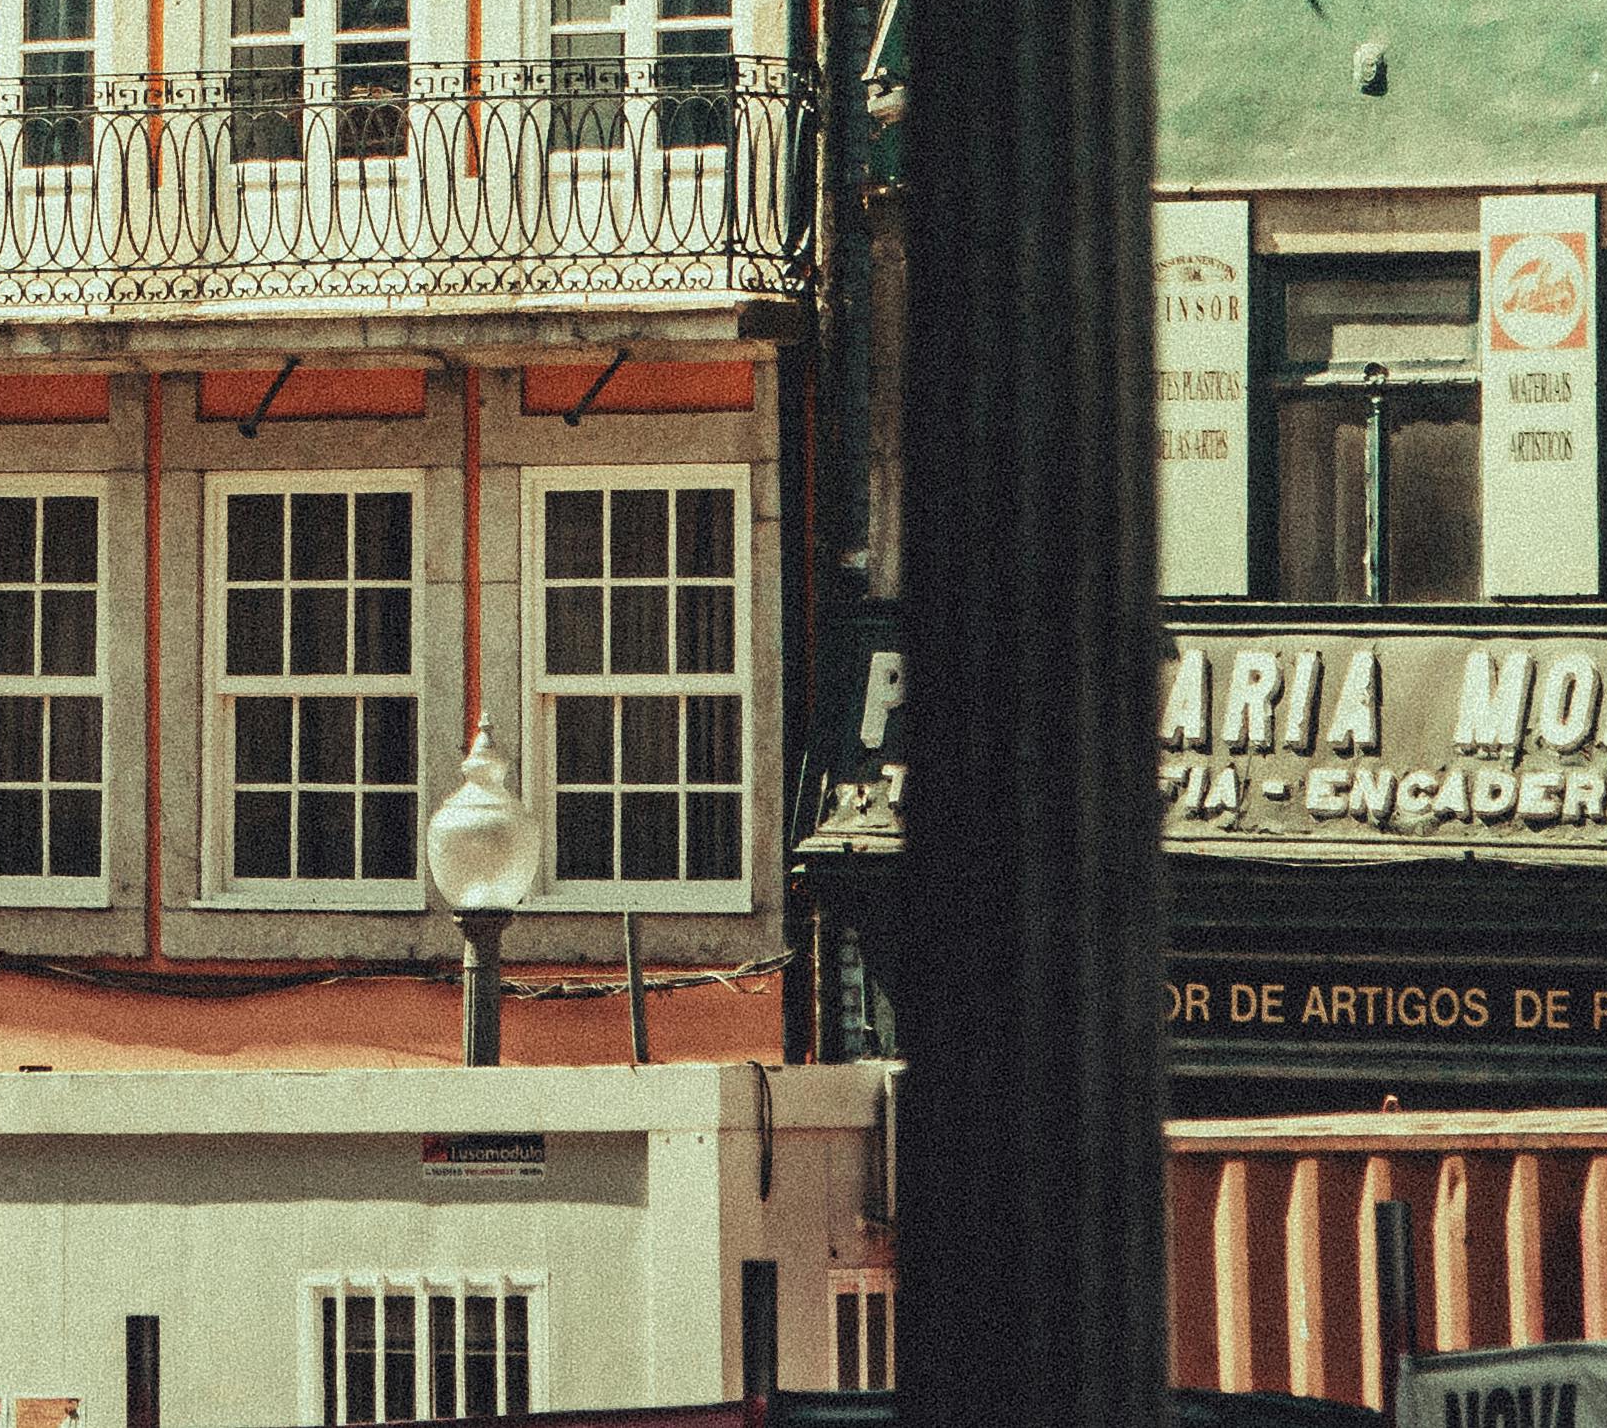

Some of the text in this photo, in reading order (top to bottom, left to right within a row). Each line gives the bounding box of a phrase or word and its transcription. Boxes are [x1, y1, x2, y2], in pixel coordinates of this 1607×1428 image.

[1165, 295, 1240, 322] INSOR
[1160, 429, 1190, 460] ELAS
[1230, 983, 1286, 1024] DE
[1301, 985, 1489, 1027] ARTIGOS
[1514, 988, 1571, 1030] DE
